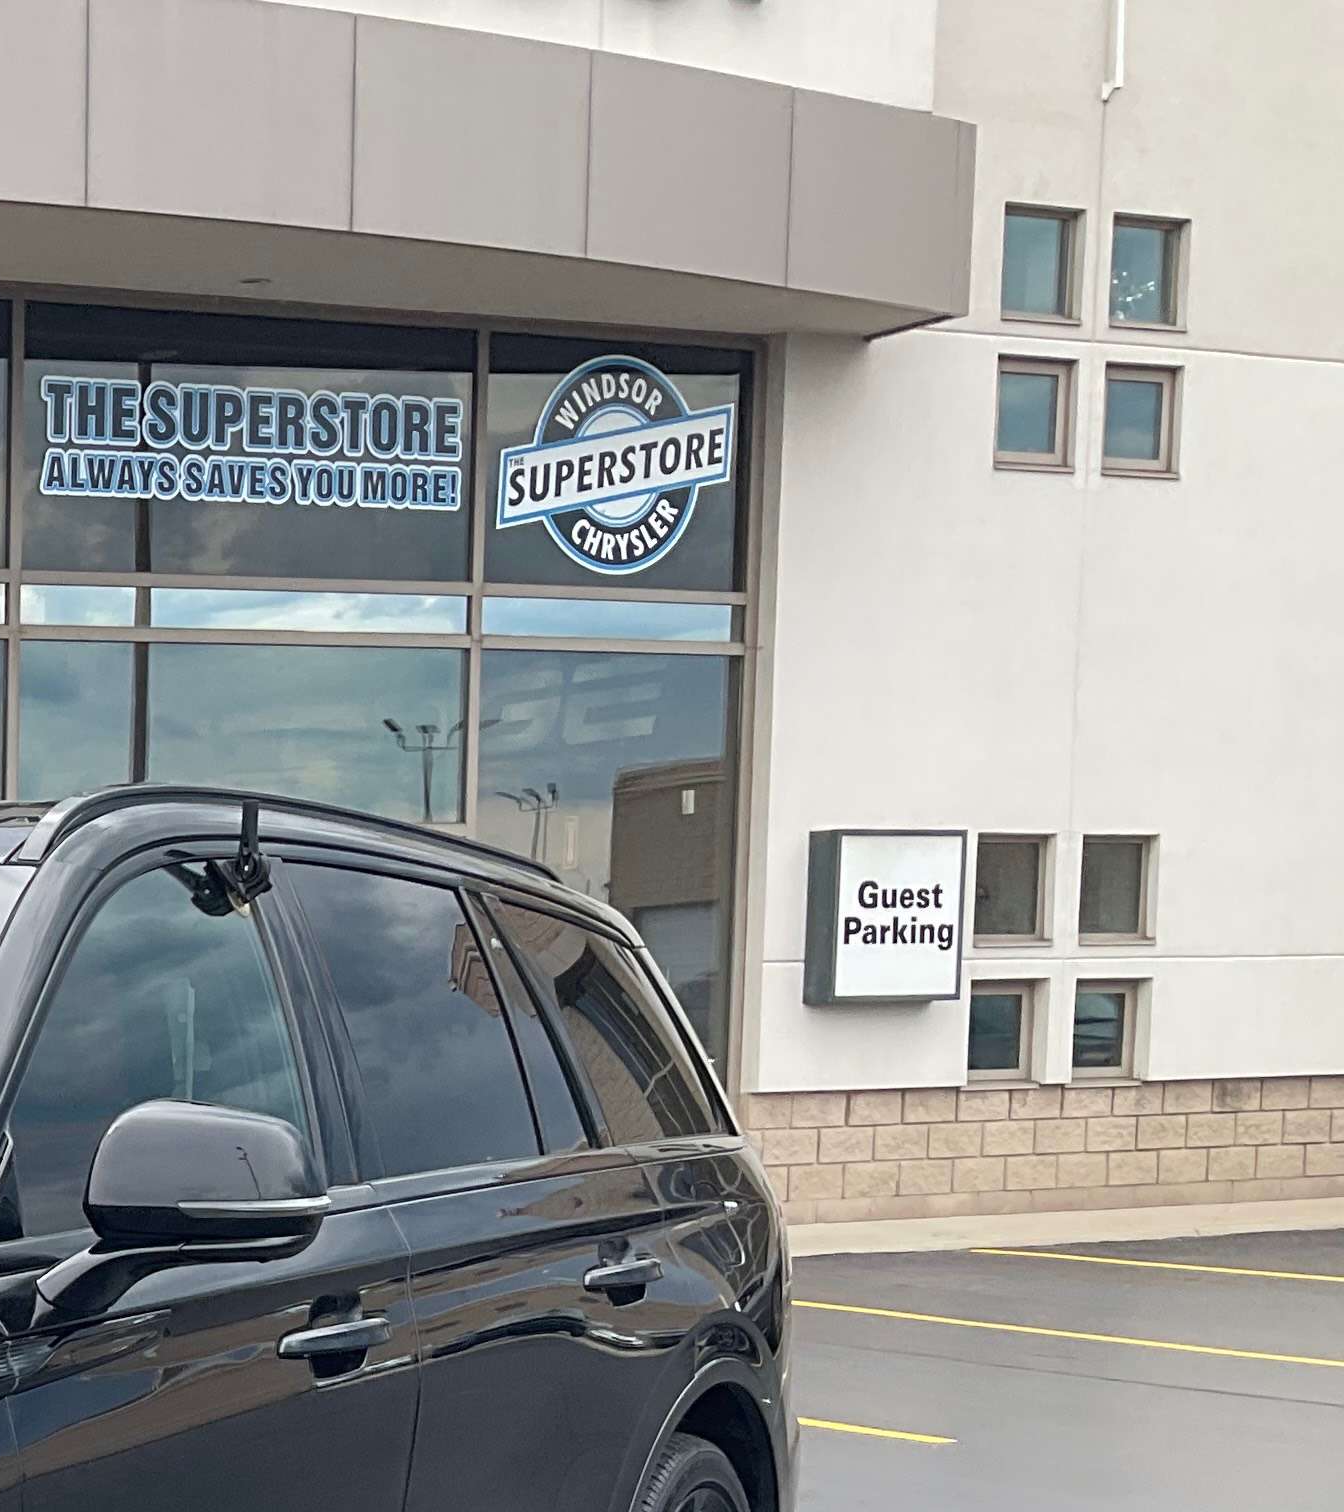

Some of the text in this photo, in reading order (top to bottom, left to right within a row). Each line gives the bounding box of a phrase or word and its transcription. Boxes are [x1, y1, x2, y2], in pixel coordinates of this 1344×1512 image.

[45, 381, 461, 455] THE SUPERSTORE
[554, 372, 663, 431] WINDSOR
[45, 452, 458, 506] ALWAYS SAVES YOU MORE!
[508, 428, 724, 506] SUPERSTORE
[509, 457, 525, 466] THE
[571, 499, 679, 560] CHRYSLER
[857, 880, 944, 909] Guest
[843, 916, 955, 951] Parking
